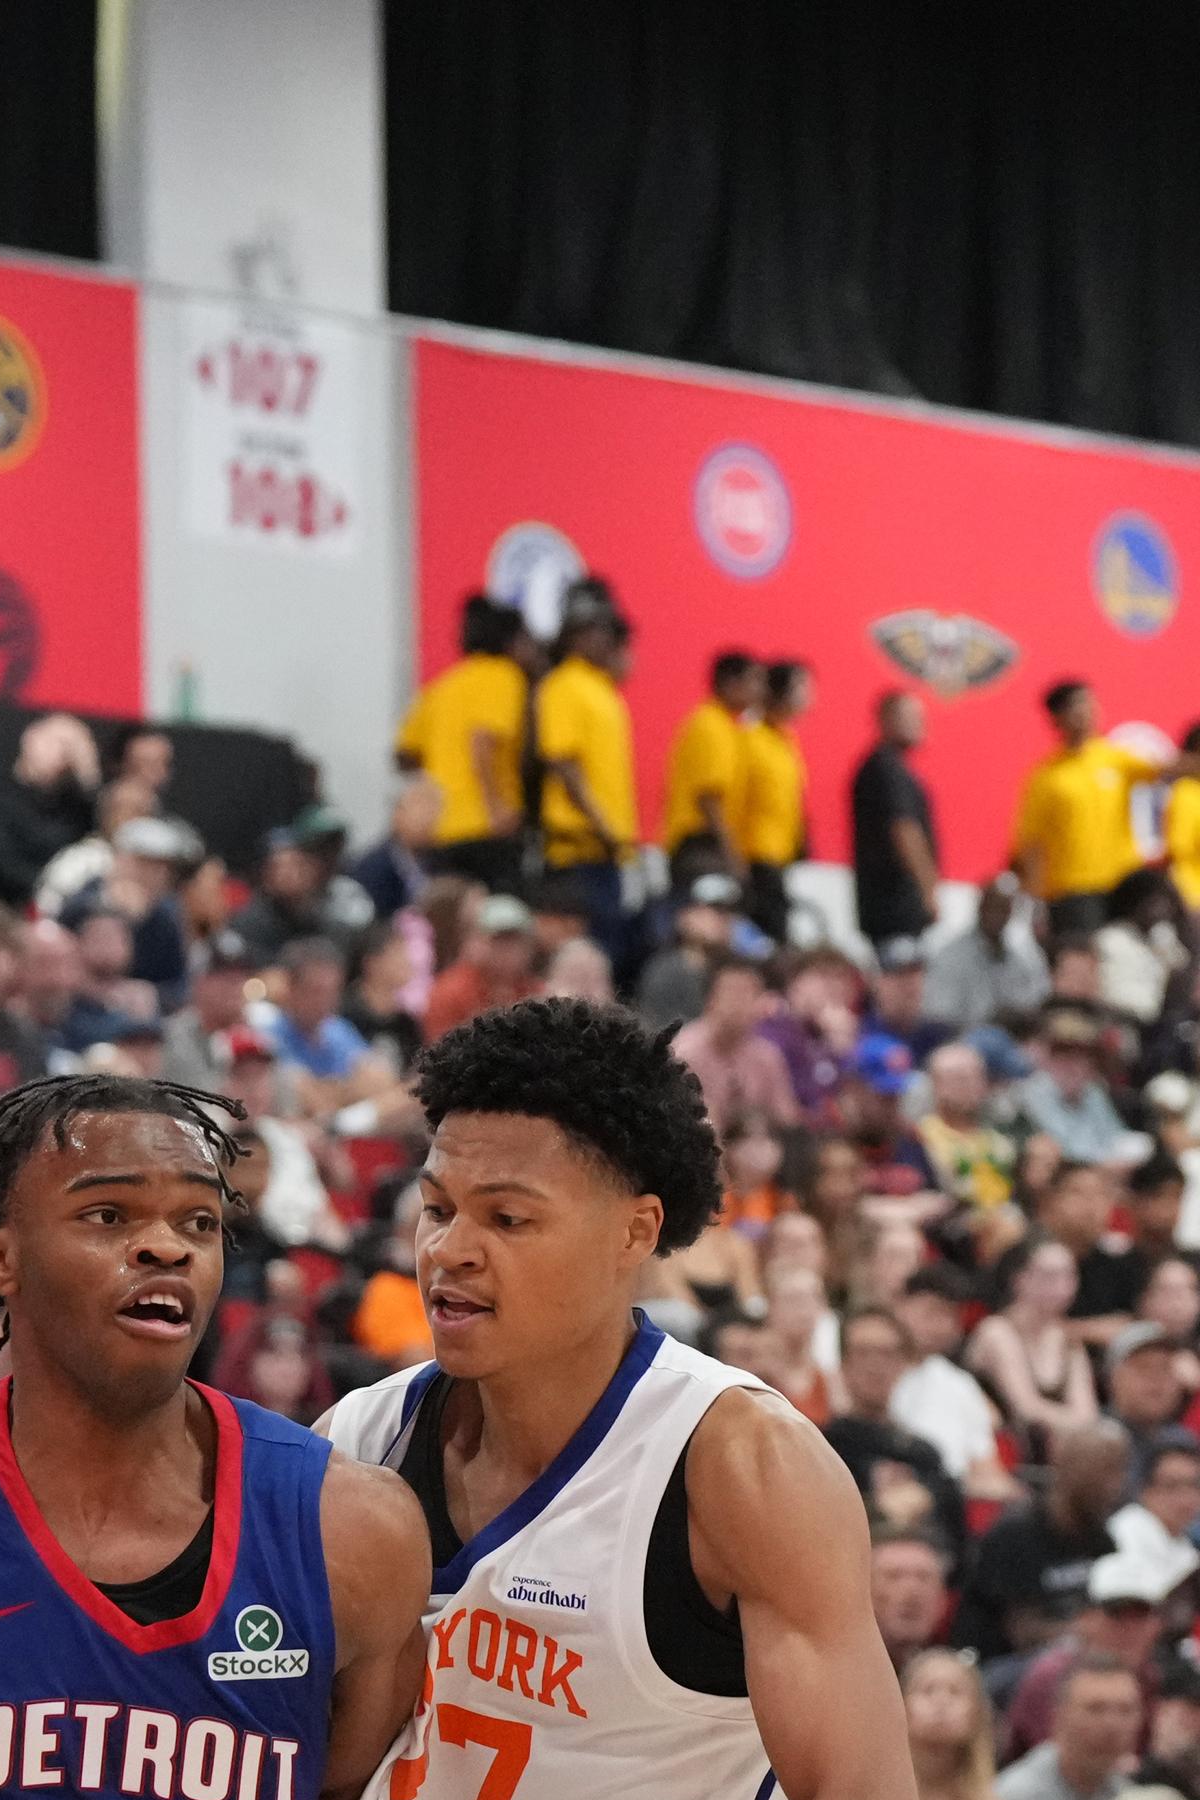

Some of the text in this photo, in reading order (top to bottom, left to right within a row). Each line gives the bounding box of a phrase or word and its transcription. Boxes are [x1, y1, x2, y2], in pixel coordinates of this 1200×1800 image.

[226, 341, 320, 416] 107
[512, 1576, 552, 1587] experience
[507, 1586, 587, 1610] abu dhabi
[212, 1653, 306, 1676] StockX
[432, 1607, 588, 1719] YORK
